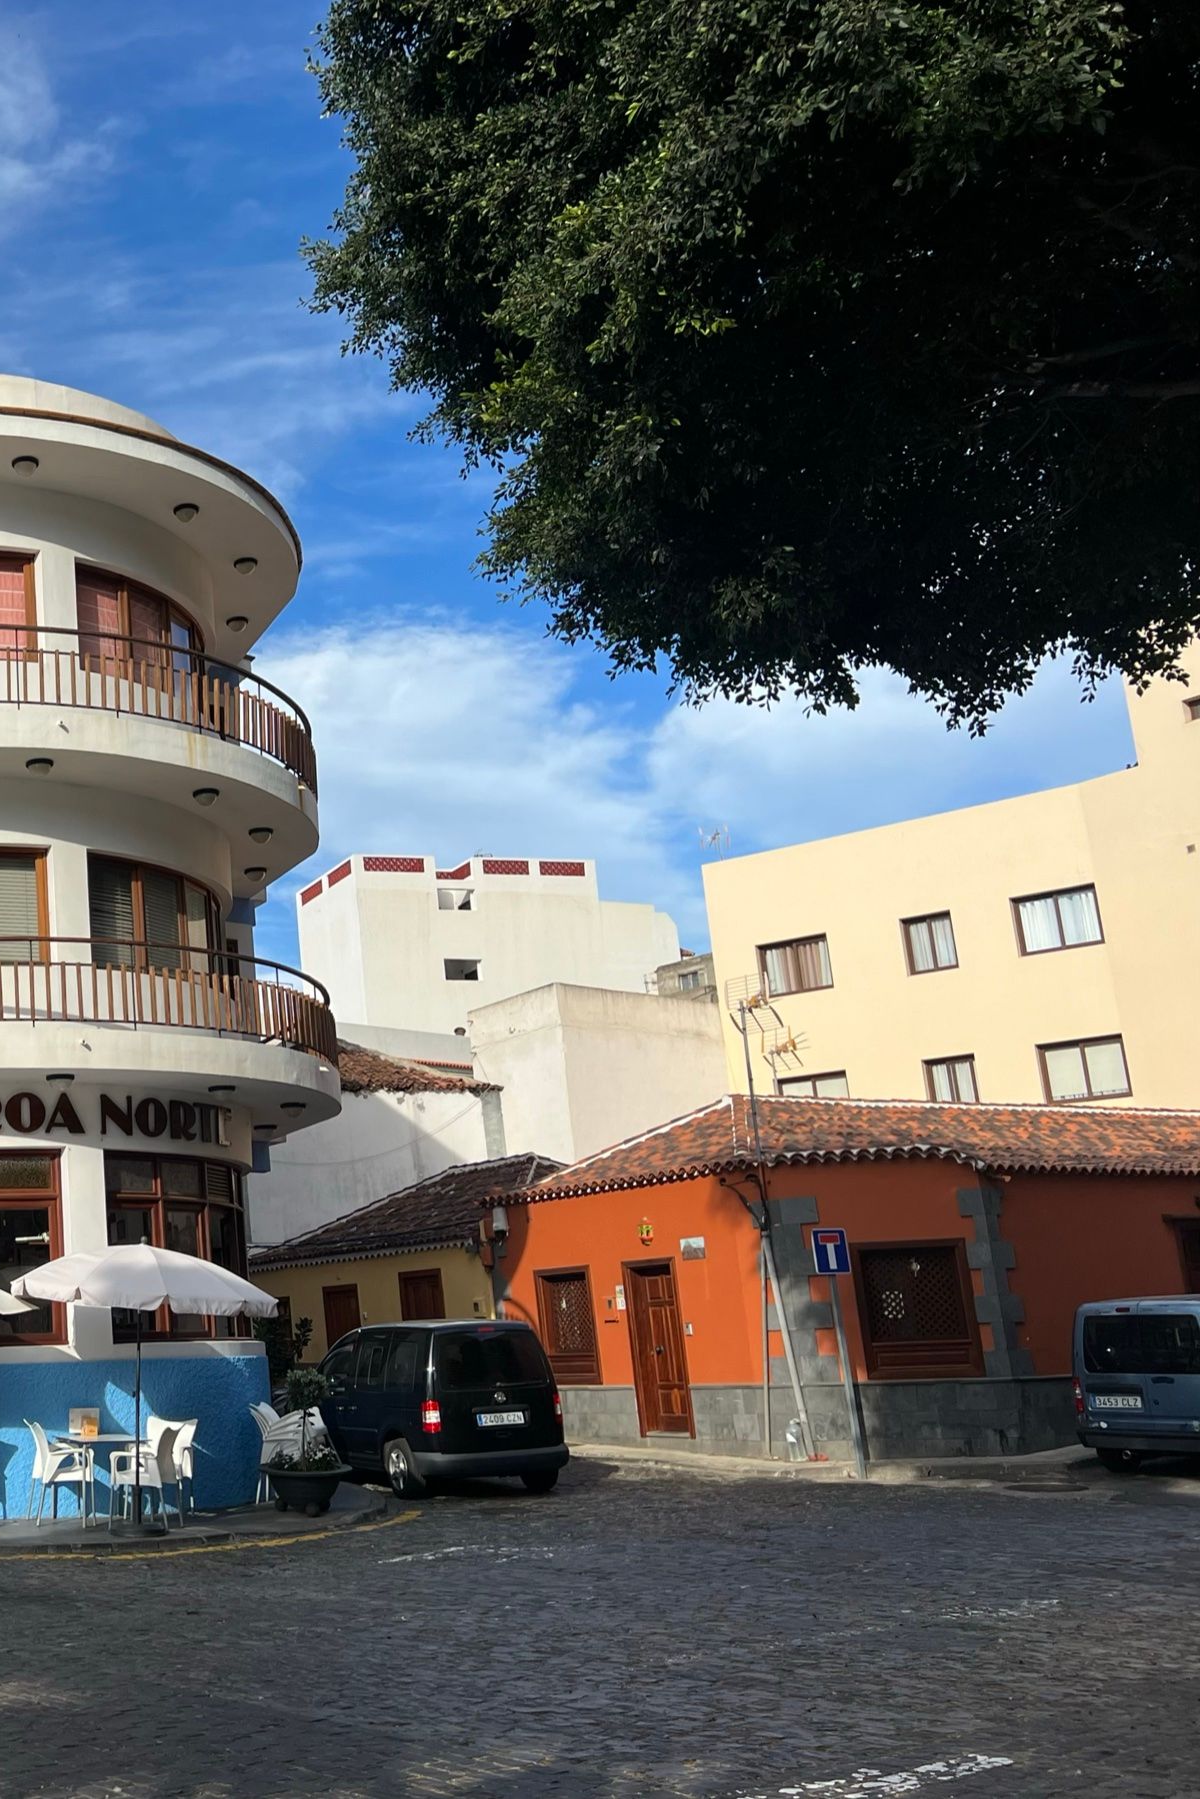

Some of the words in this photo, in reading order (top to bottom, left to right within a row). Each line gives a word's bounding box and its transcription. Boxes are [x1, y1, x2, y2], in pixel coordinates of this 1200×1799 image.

[99, 1094, 233, 1147] NORTE
[1096, 1398, 1119, 1407] 3453
[1121, 1397, 1139, 1407] CLZ
[483, 1415, 505, 1425] 2409
